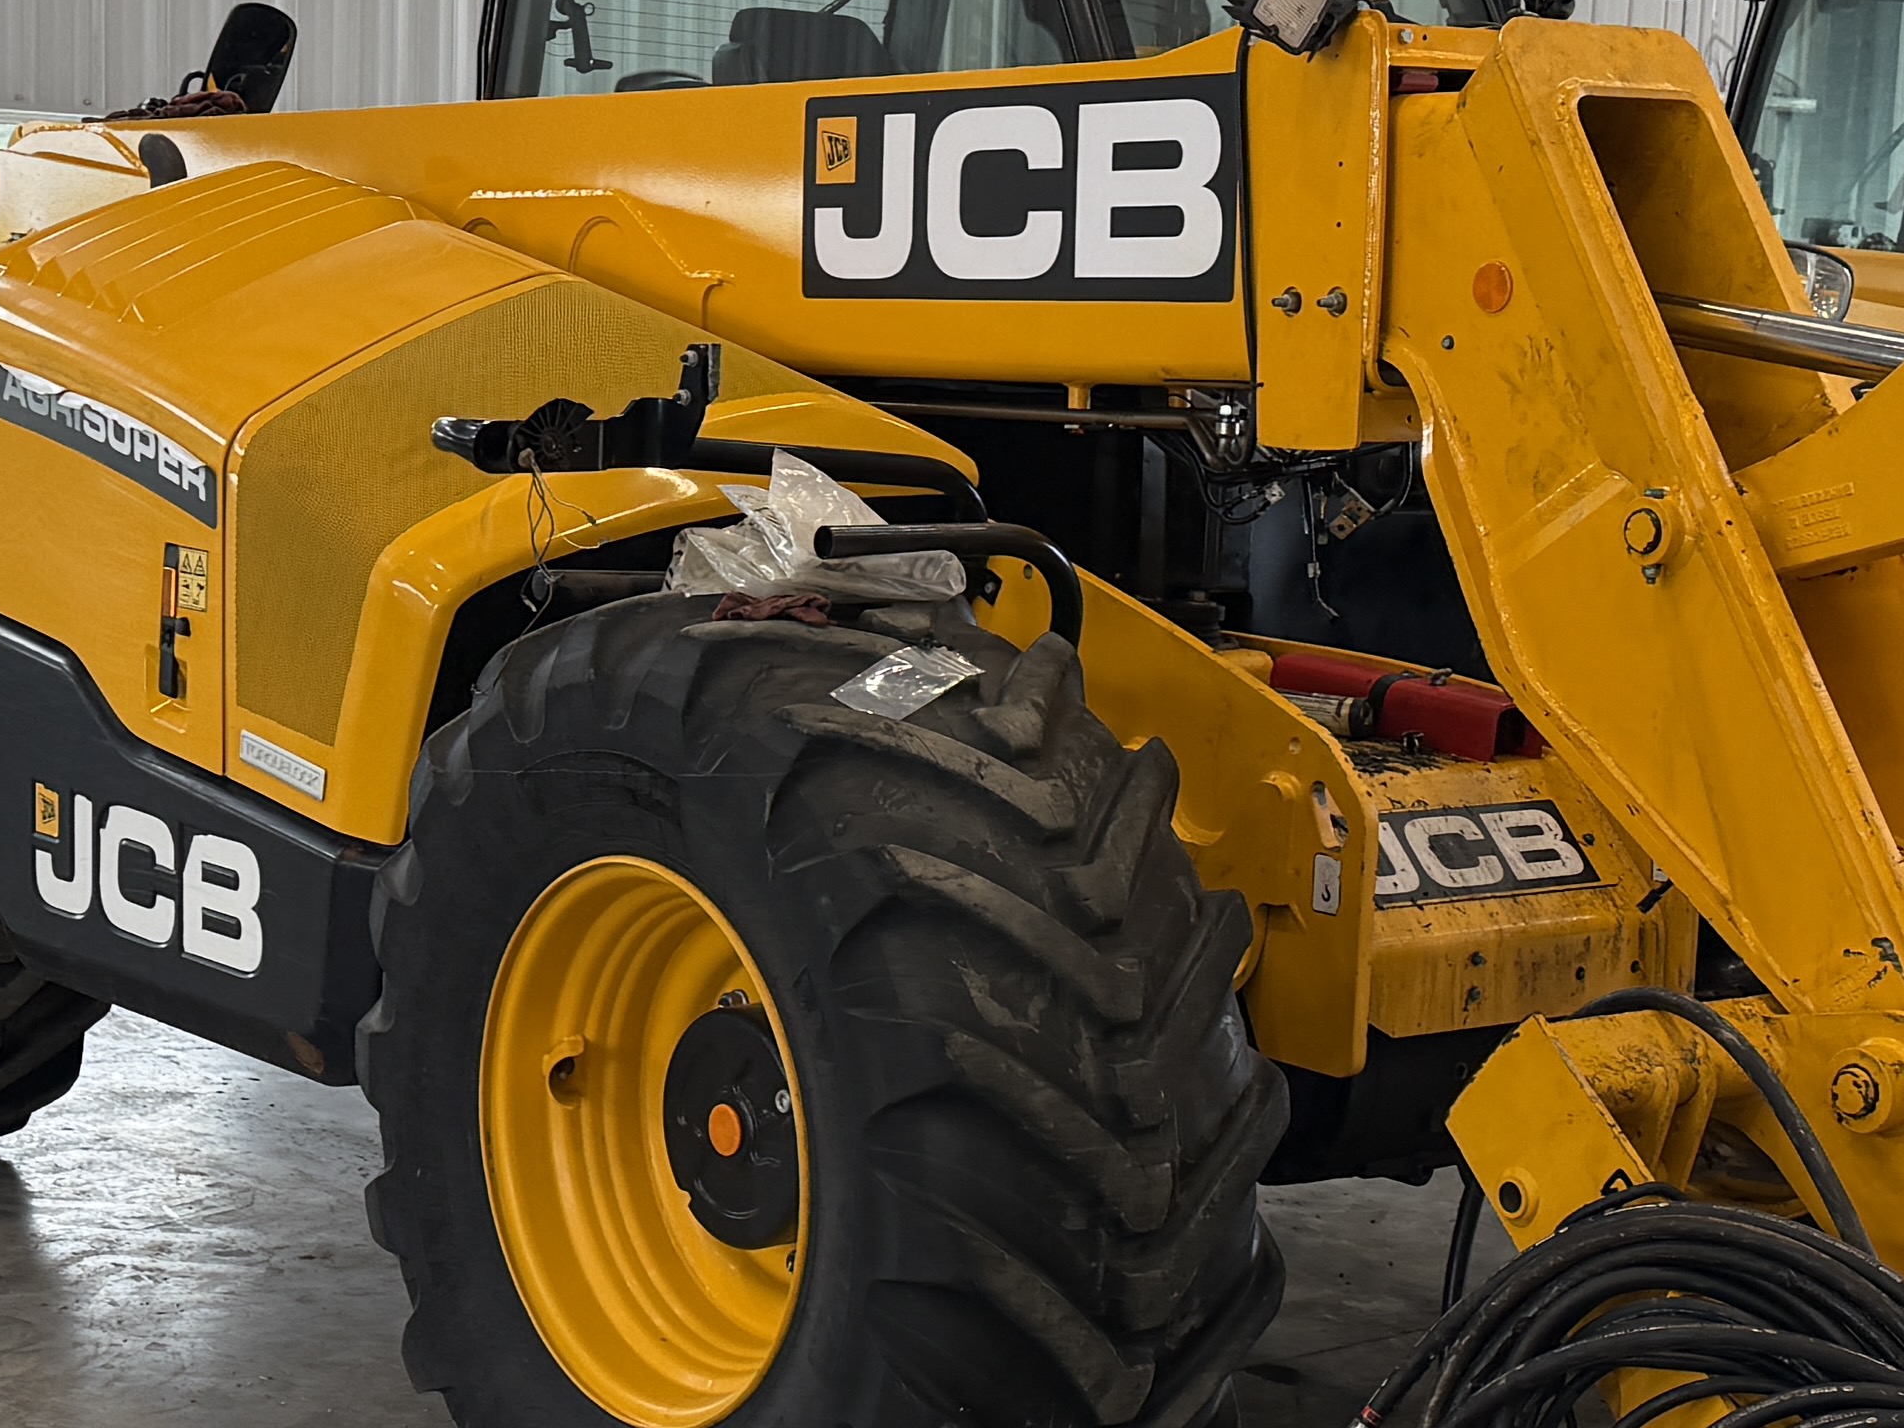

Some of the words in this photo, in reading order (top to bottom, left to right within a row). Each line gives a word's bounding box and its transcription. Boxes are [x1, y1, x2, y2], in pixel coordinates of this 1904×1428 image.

[815, 99, 1223, 280] JCB
[825, 134, 851, 165] JCB
[35, 794, 264, 973] JCB
